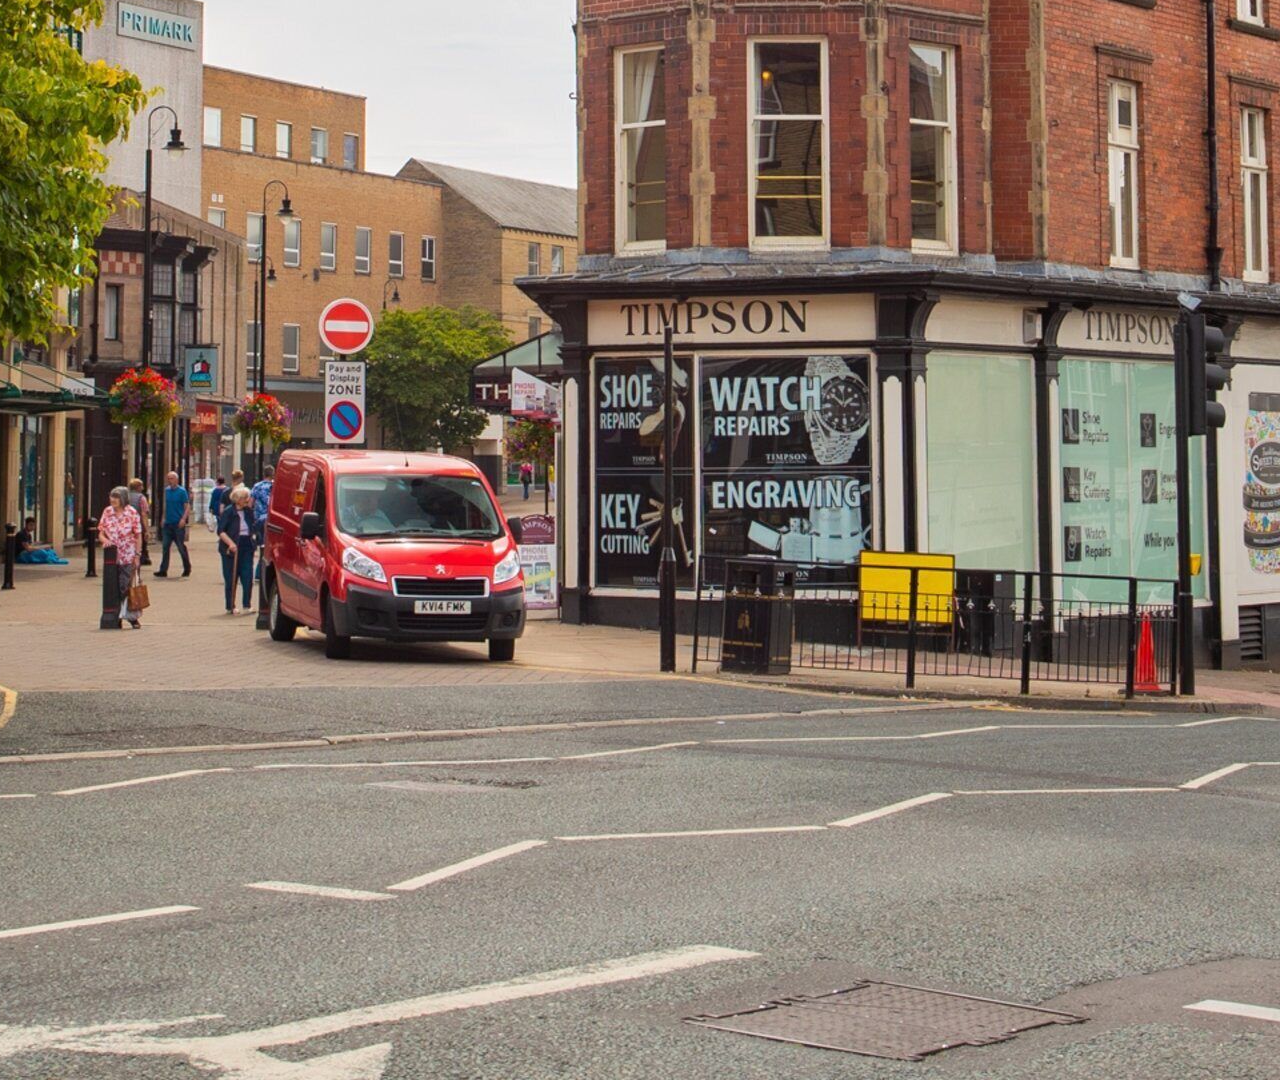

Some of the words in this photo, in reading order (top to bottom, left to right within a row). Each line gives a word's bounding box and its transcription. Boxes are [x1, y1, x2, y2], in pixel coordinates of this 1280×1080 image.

[121, 10, 193, 43] PRIMARK
[621, 299, 810, 336] TIMPSON
[329, 364, 345, 373] Pay
[330, 374, 360, 383] Display
[328, 384, 362, 395] ZONE
[600, 373, 653, 408] SHOE
[709, 376, 821, 411] WATCH
[600, 411, 642, 430] REPAIRS
[1082, 411, 1101, 424] Shoe
[714, 416, 790, 437] REPAIRS
[1082, 428, 1110, 445] Repairs
[765, 453, 808, 461] TIMPSON
[1083, 468, 1096, 483] Key
[712, 479, 861, 509] ENGRAVING
[1083, 485, 1110, 502] Cutting
[601, 493, 641, 530] KEY
[521, 520, 553, 534] IMPSON
[1084, 526, 1107, 540] Watch
[601, 534, 650, 555] CUTTING
[1144, 533, 1162, 548] While
[1162, 536, 1175, 551] you
[1084, 544, 1112, 560] Repairs
[421, 601, 444, 612] KV14
